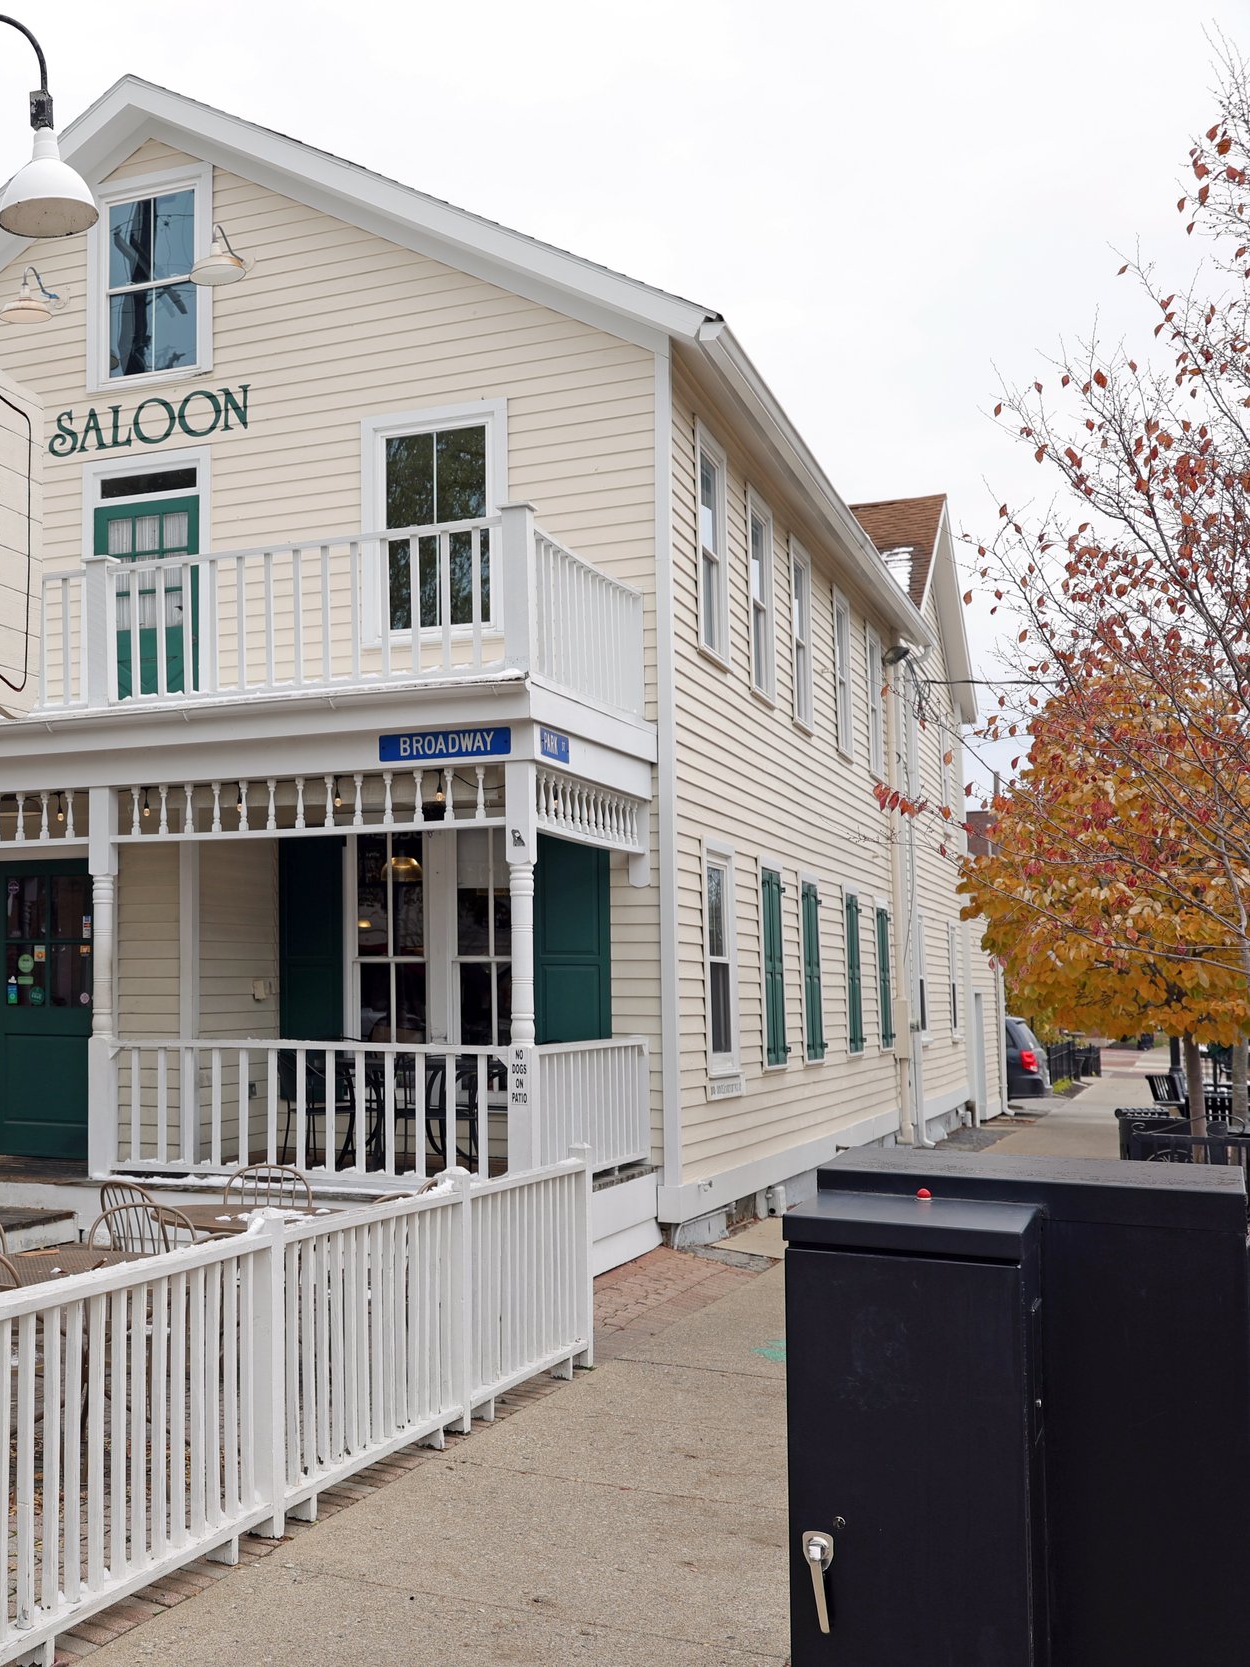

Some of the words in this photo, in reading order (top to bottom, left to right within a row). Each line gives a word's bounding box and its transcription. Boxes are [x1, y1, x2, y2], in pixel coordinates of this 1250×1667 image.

[48, 383, 252, 458] SALOON
[399, 731, 495, 757] BROADWAY
[543, 732, 559, 756] PARK
[515, 1050, 524, 1060] NO
[512, 1064, 527, 1074] DOGS
[516, 1078, 523, 1088] ON
[512, 1092, 527, 1103] PATIO
